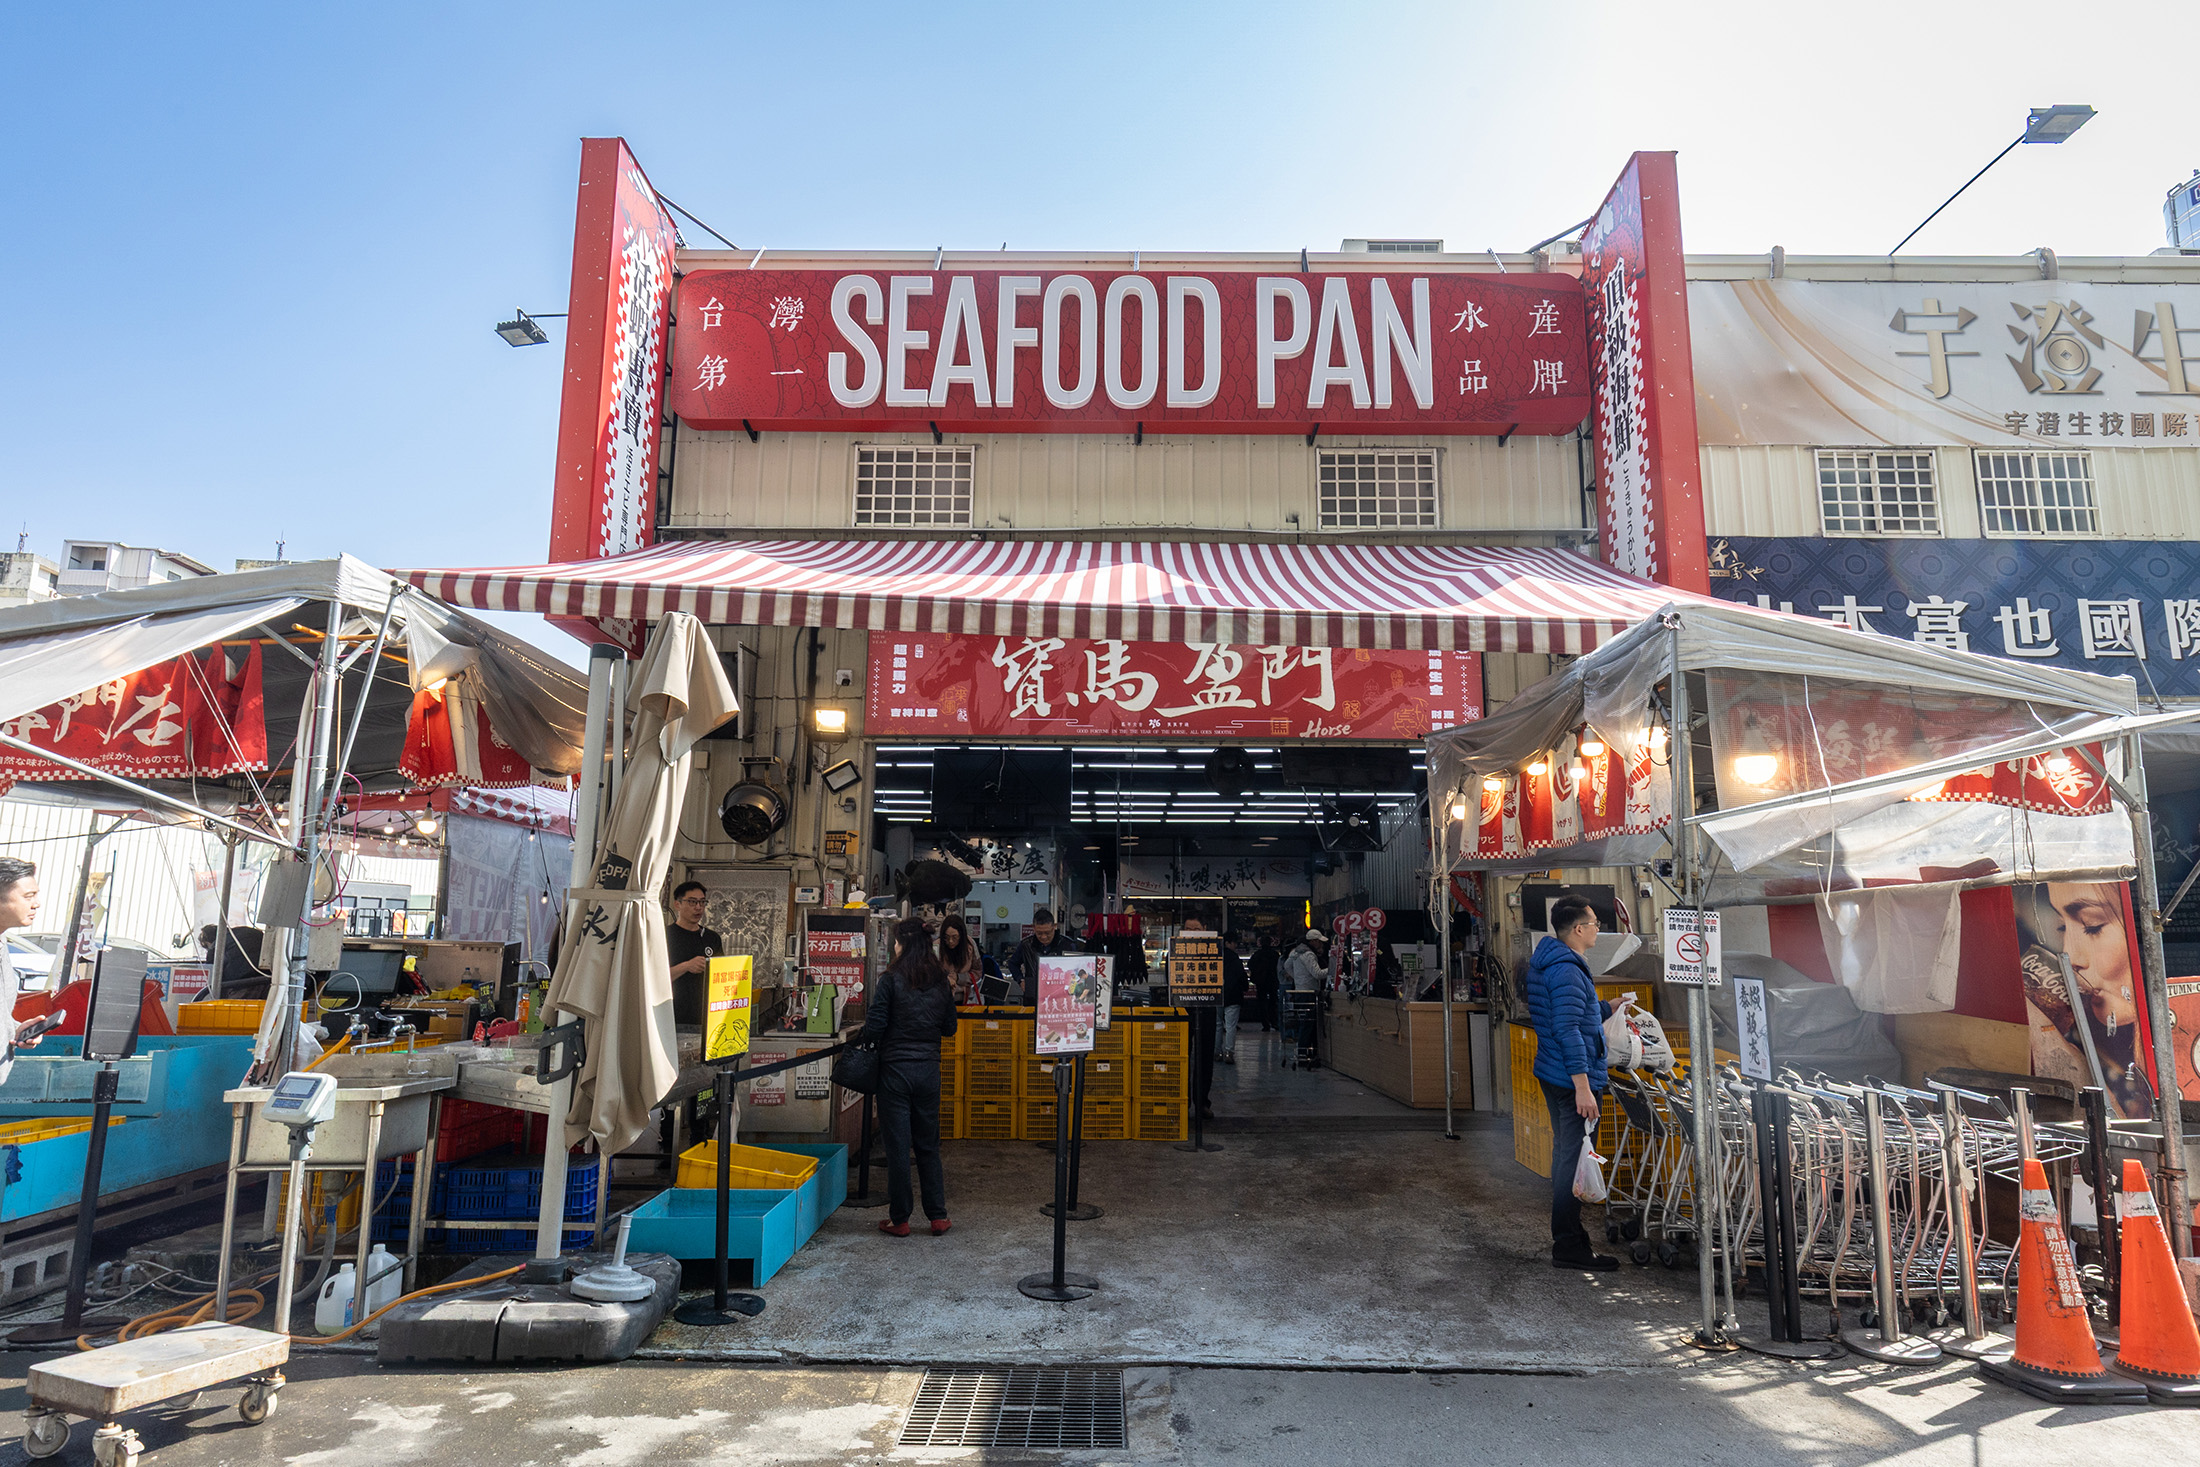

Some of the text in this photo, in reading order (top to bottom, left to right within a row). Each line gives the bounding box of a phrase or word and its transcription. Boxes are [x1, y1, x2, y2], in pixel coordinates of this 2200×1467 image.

[699, 296, 804, 332] 台灣
[1450, 300, 1563, 339] 水産
[828, 274, 1434, 410] SEAFOOD PAN
[691, 355, 804, 392] 第一
[1459, 359, 1568, 396] 品牌
[1603, 260, 1634, 463] 頂級海鮮
[2003, 410, 2200, 438] 宇澄生技國際
[1300, 717, 1353, 739] Horse
[1338, 919, 1346, 934] 1
[1349, 913, 1362, 930] 2
[1368, 910, 1382, 928] 3
[2044, 1226, 2074, 1307] 請勿任意移動
